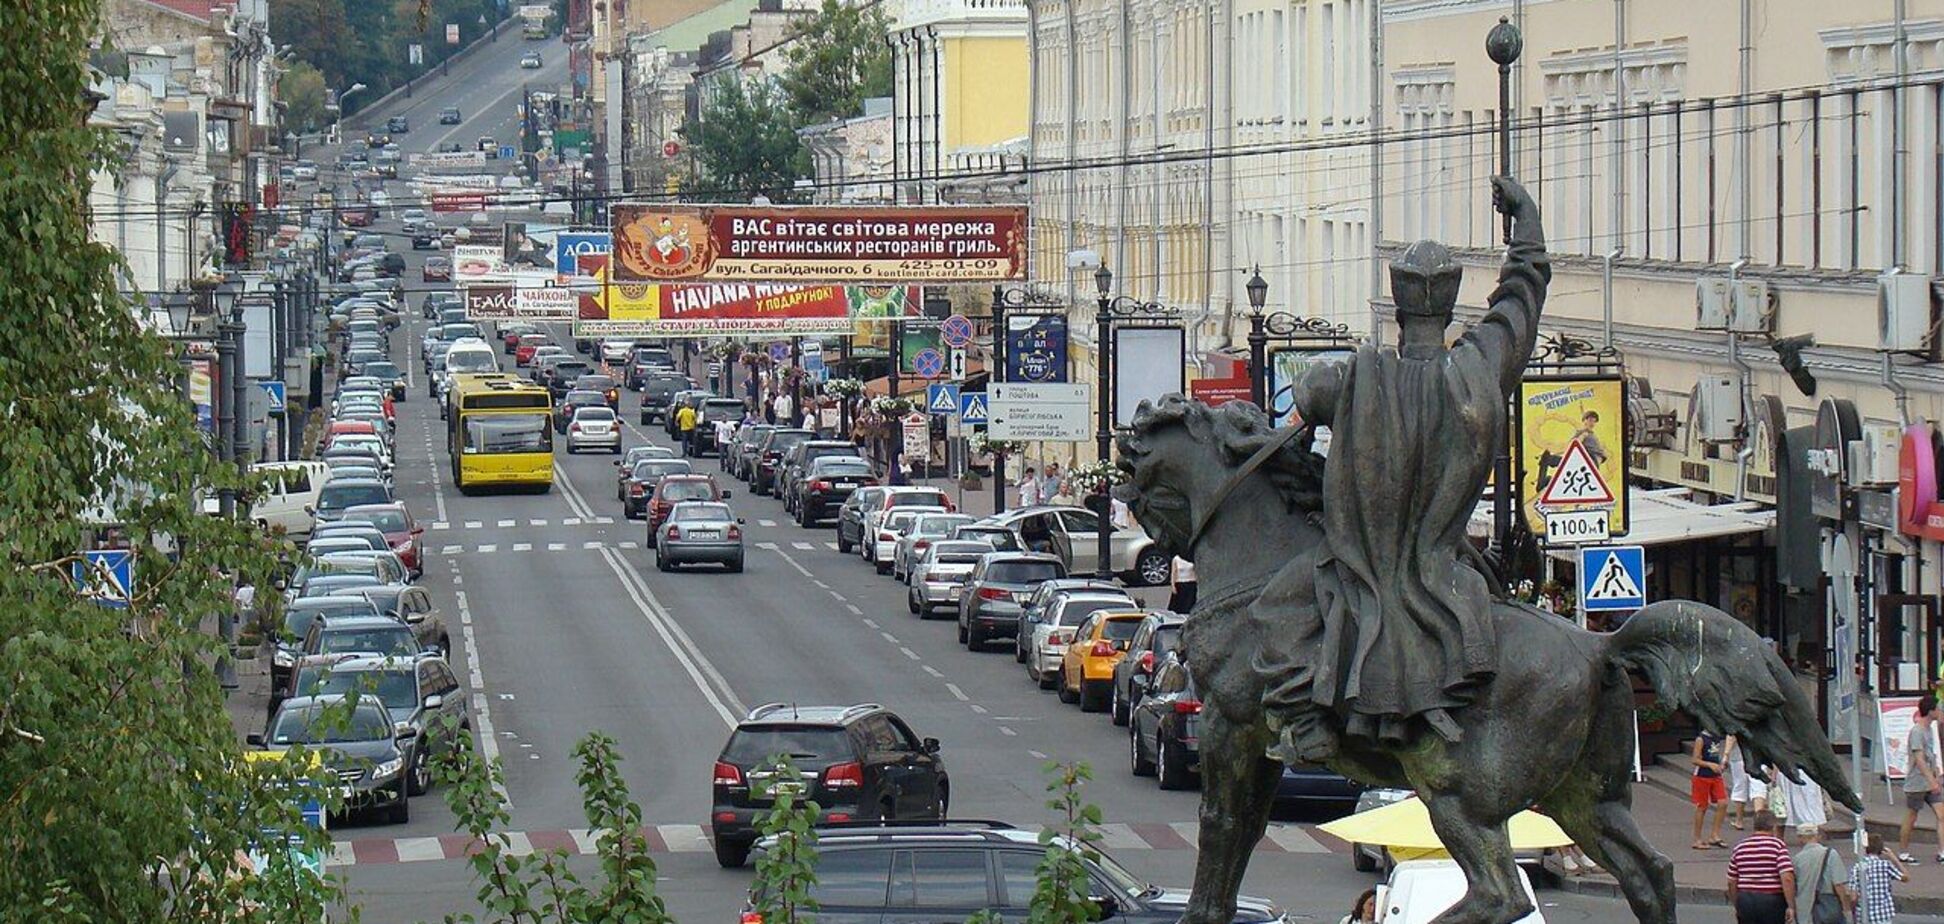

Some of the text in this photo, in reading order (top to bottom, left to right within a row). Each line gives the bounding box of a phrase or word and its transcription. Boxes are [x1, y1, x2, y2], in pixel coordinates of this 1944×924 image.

[732, 218, 996, 239] ВАС вітає світова мережа
[731, 237, 1001, 257] аргентинських ресторанів гриль.
[716, 262, 873, 277] вул. Сагайдачного, 6
[877, 268, 1000, 278] kontinent-card.com.ua
[899, 260, 998, 270] 425-01-09
[672, 284, 751, 313] HAVANA
[756, 300, 763, 312] У
[766, 286, 834, 311] ПОДАРУНОК!
